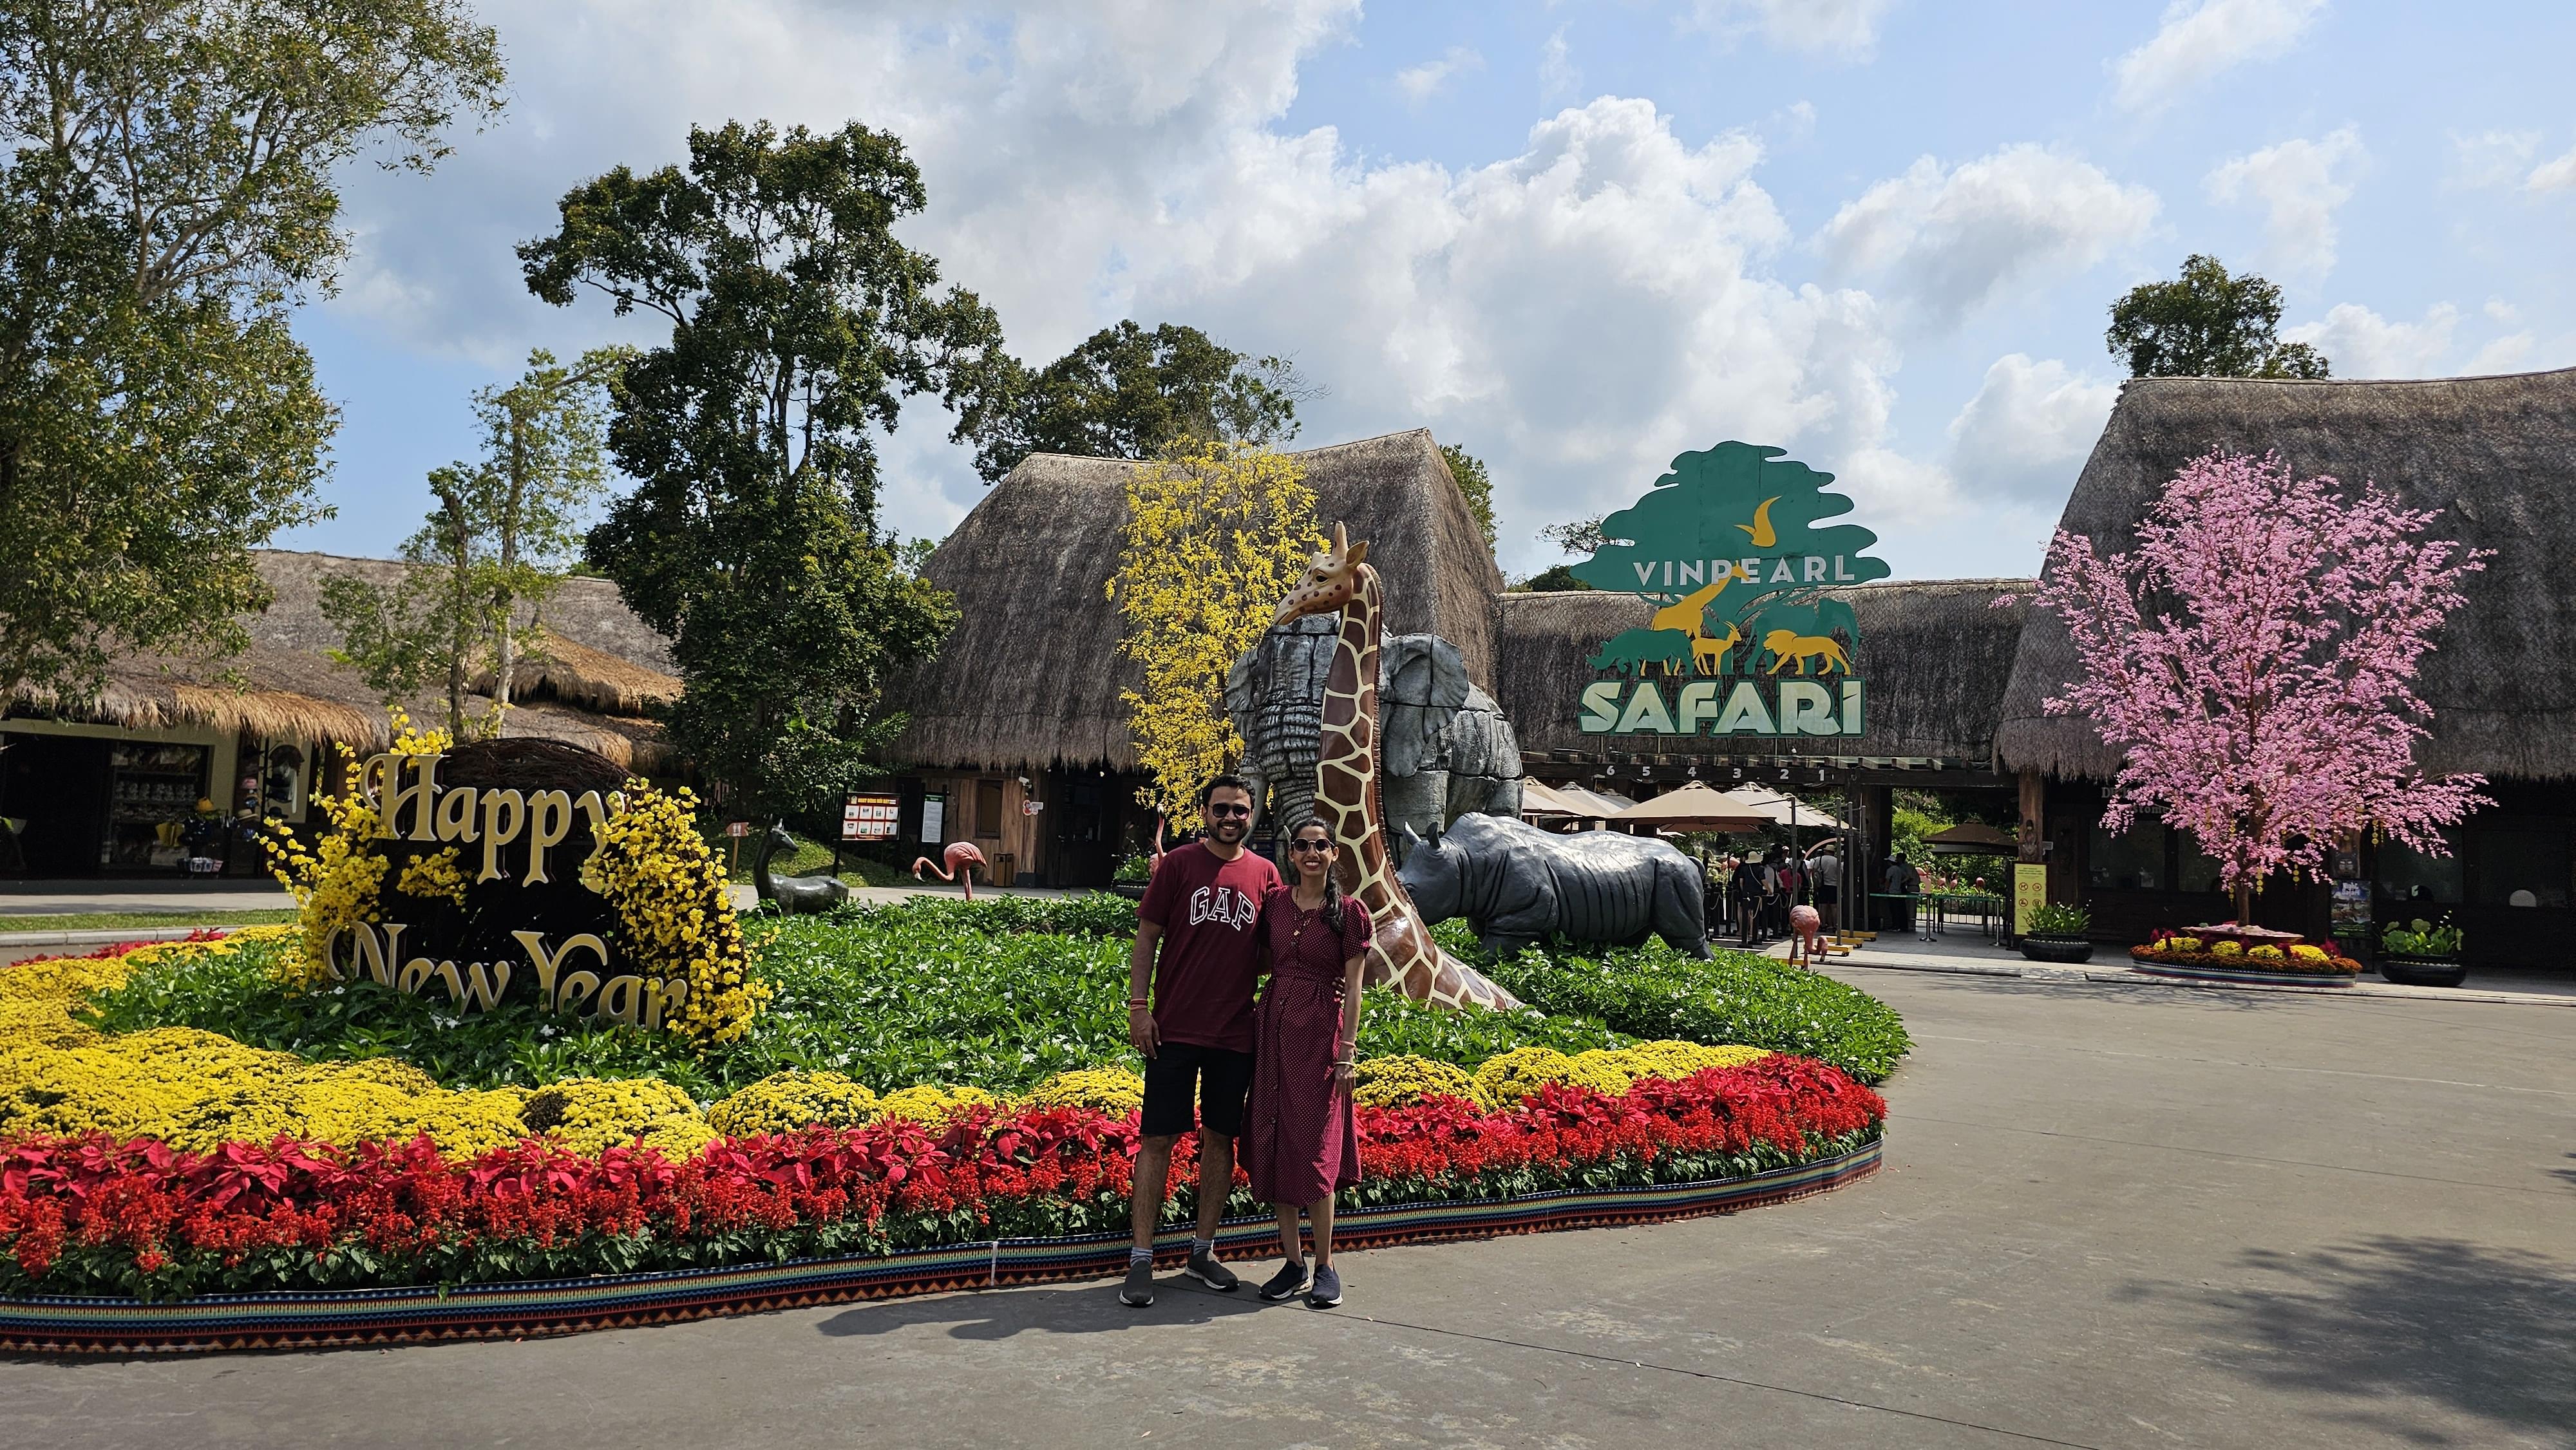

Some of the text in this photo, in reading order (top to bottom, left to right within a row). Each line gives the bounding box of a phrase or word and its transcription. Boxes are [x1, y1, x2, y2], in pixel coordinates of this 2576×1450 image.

[1633, 555, 1855, 587] VINPEARL
[1579, 680, 1862, 736] SAFARI
[1606, 766, 1615, 776] 6
[1642, 766, 1651, 777] 5
[1687, 767, 1697, 777] 4
[1732, 768, 1742, 778] 3
[1779, 769, 1789, 780] 2
[1818, 769, 1825, 781] 1
[359, 753, 626, 894] Happy
[1189, 885, 1256, 932] GAP
[323, 921, 687, 1030] New Year
